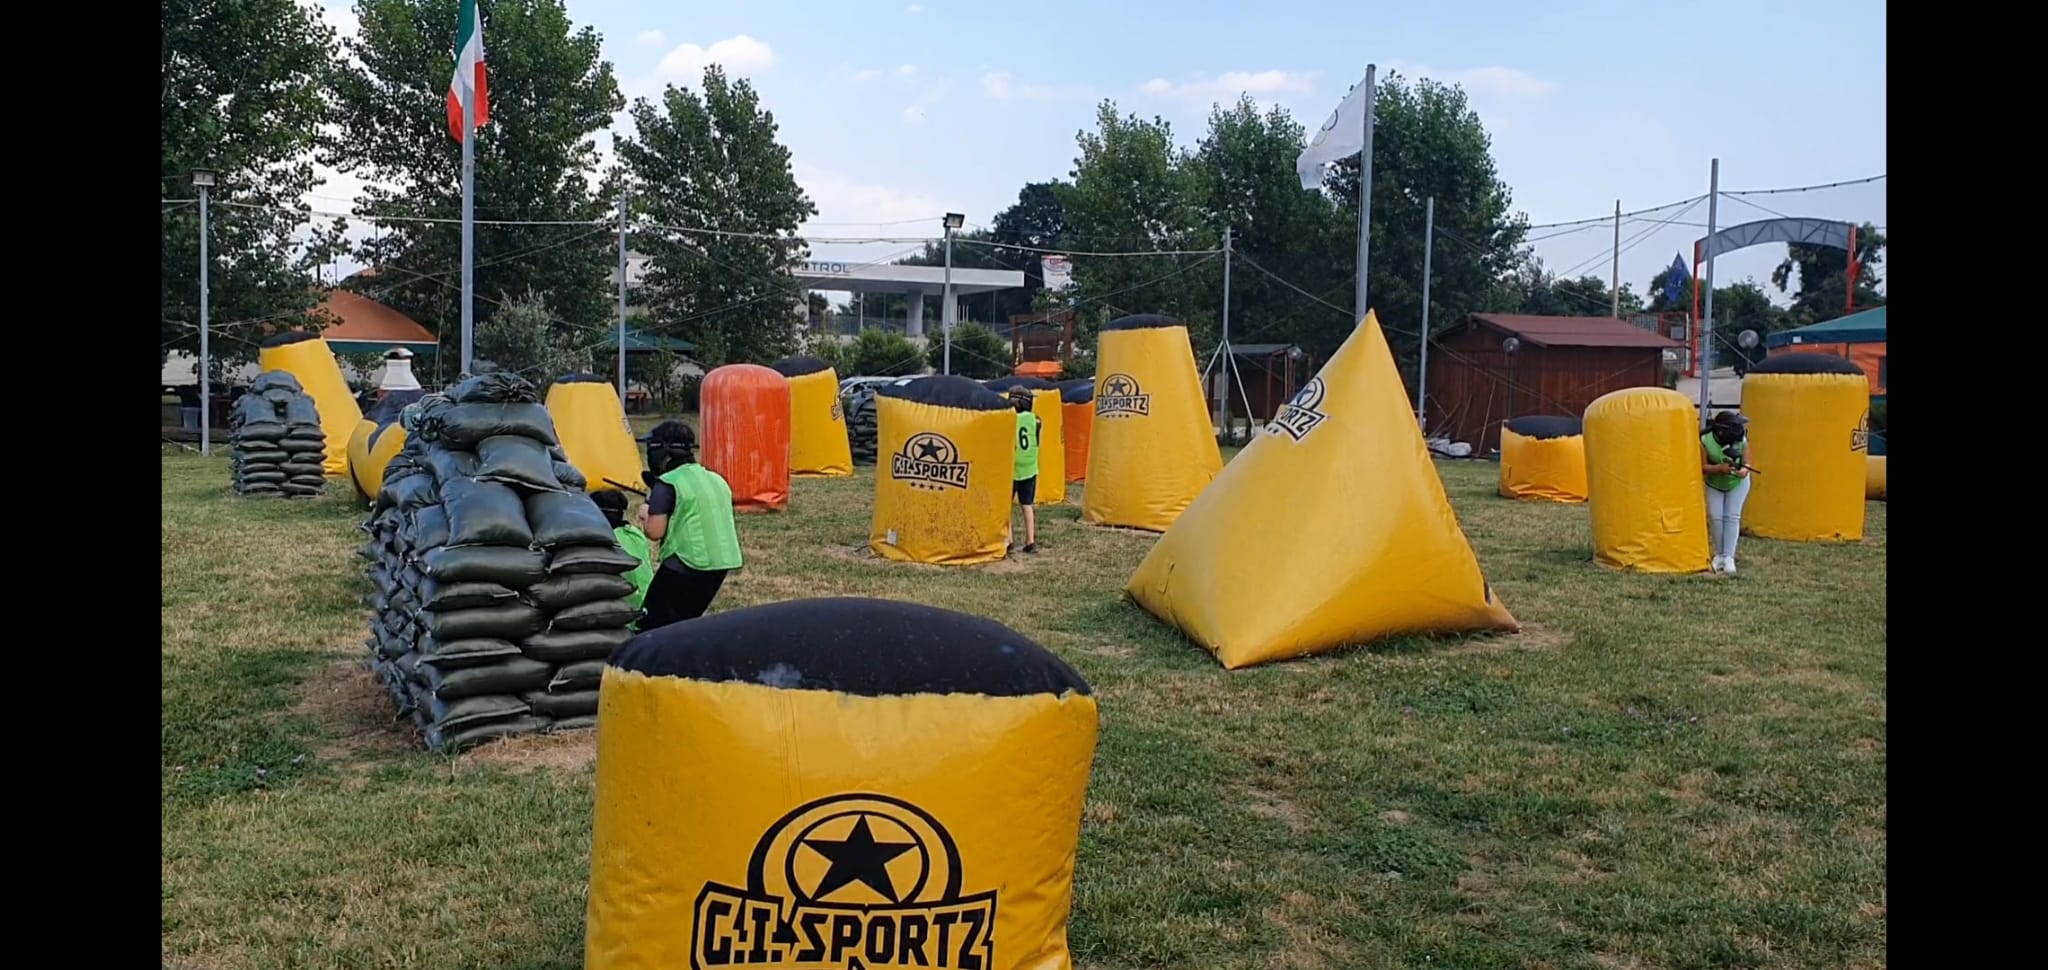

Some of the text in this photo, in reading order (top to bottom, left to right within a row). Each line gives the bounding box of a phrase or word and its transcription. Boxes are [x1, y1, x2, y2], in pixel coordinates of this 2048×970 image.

[1019, 426, 1029, 450] 6
[914, 462, 966, 483] SPORTZ
[795, 908, 987, 970] SPORTZ
